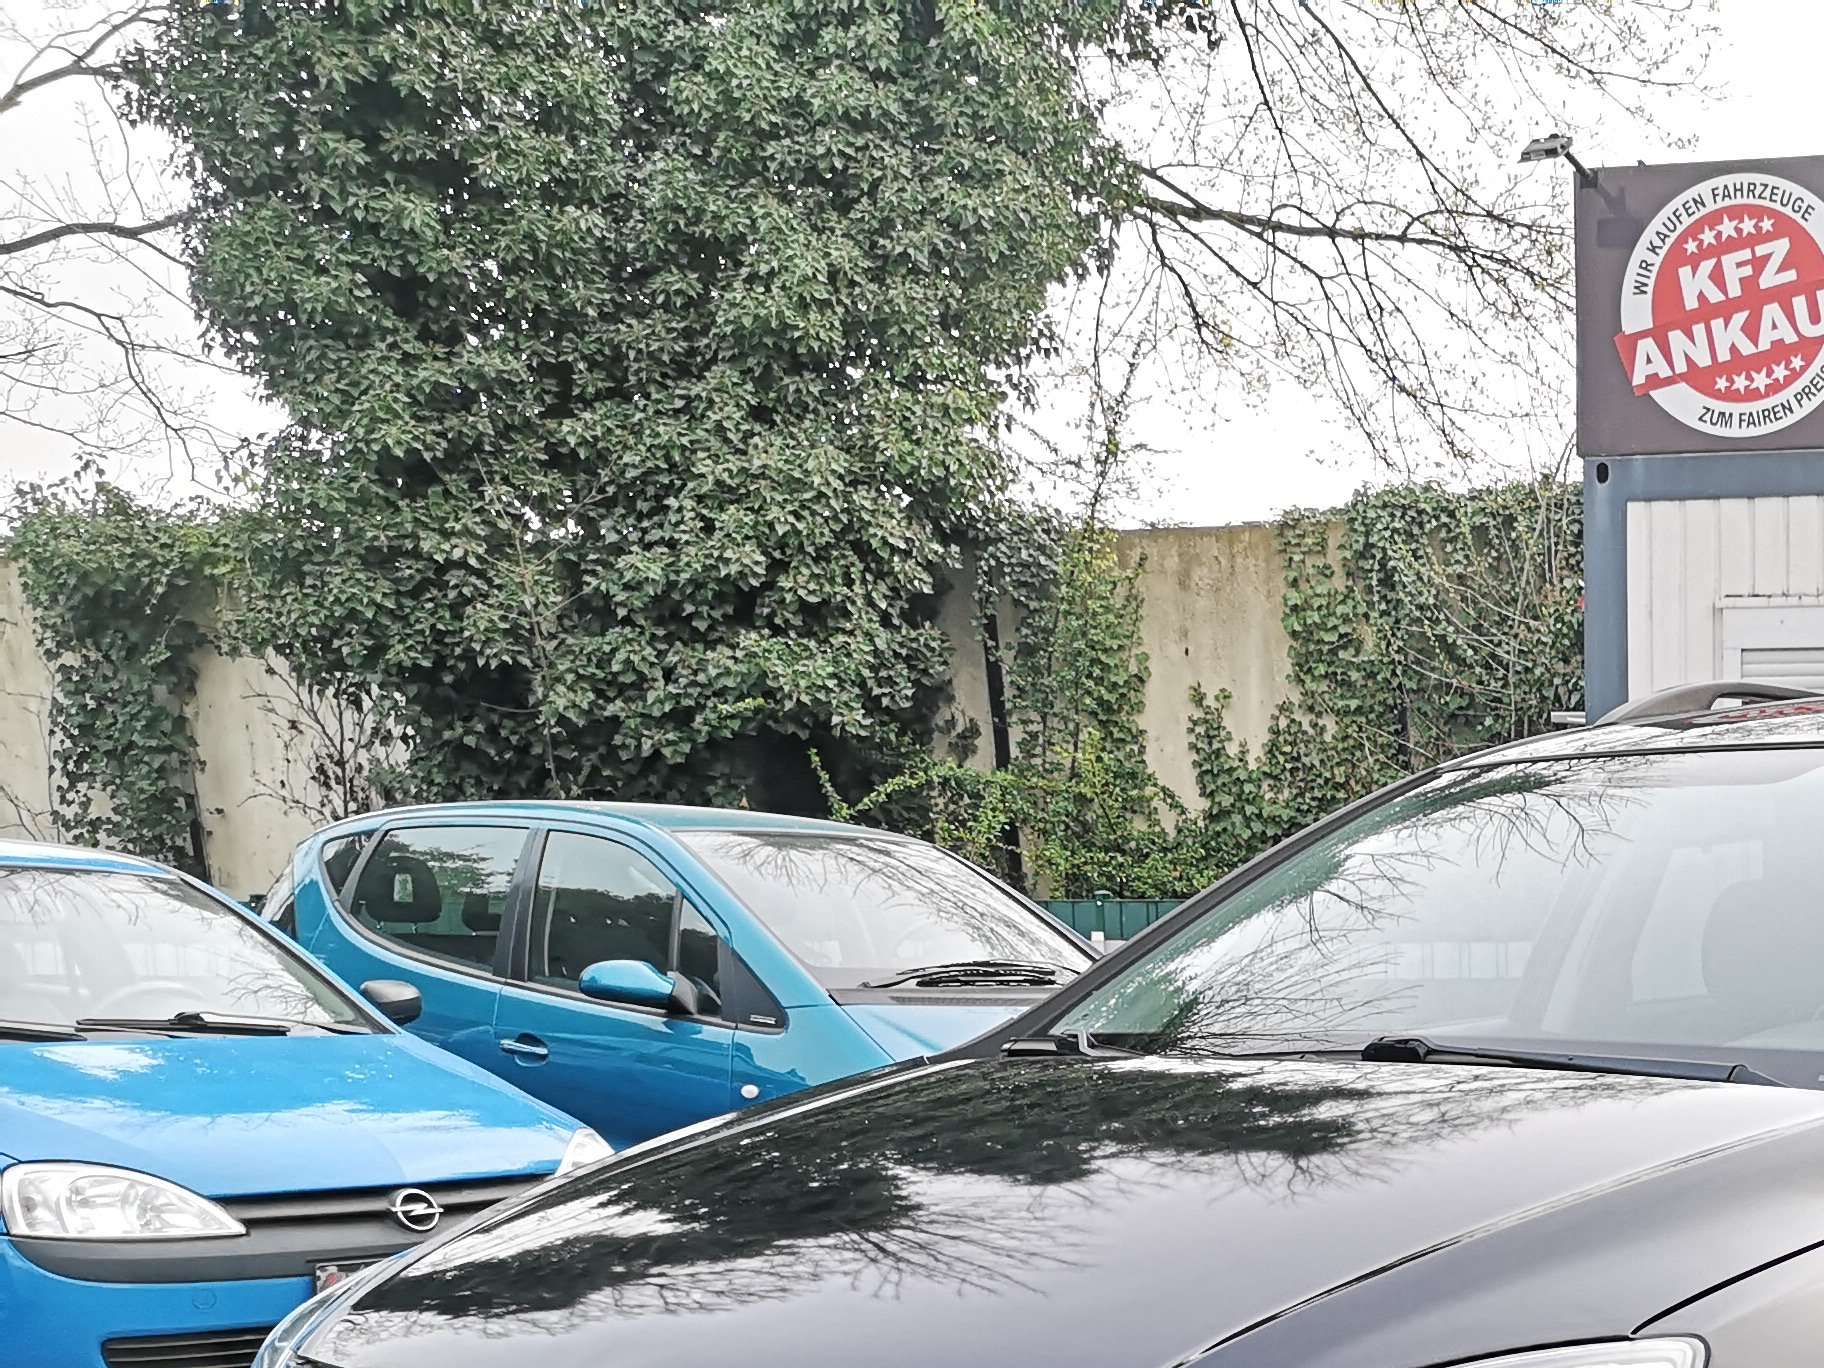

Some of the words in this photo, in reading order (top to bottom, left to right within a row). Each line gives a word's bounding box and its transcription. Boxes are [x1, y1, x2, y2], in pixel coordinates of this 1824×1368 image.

[1632, 260, 1656, 296] WIR
[1651, 193, 1706, 254] KAUFEN
[1711, 181, 1816, 223] FAHRZEUGE
[1677, 237, 1798, 311] KFZ
[1698, 405, 1734, 430] ZUM
[1738, 399, 1794, 429] FAIREN
